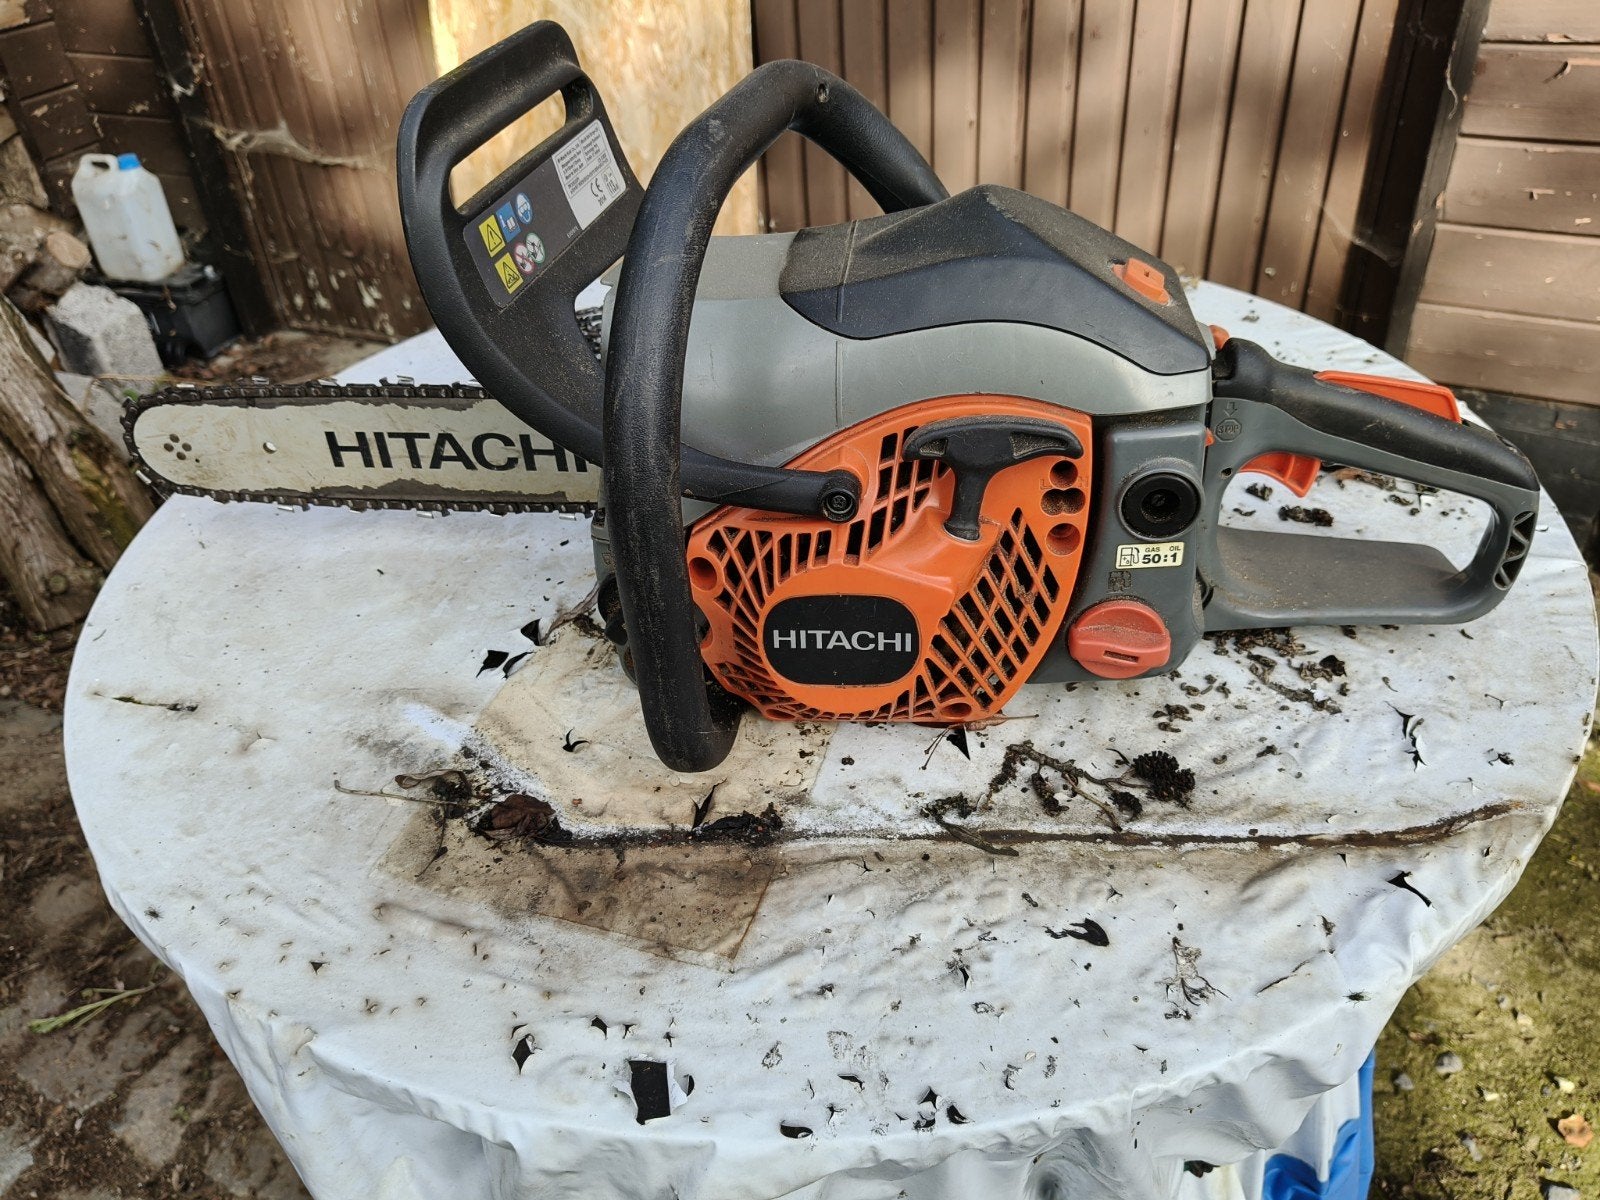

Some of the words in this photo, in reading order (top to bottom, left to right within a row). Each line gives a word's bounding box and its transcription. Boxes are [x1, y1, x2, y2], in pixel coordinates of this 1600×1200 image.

[1218, 424, 1239, 433] STOP
[1141, 552, 1178, 565] 50:1
[773, 629, 912, 652] HITACHI
